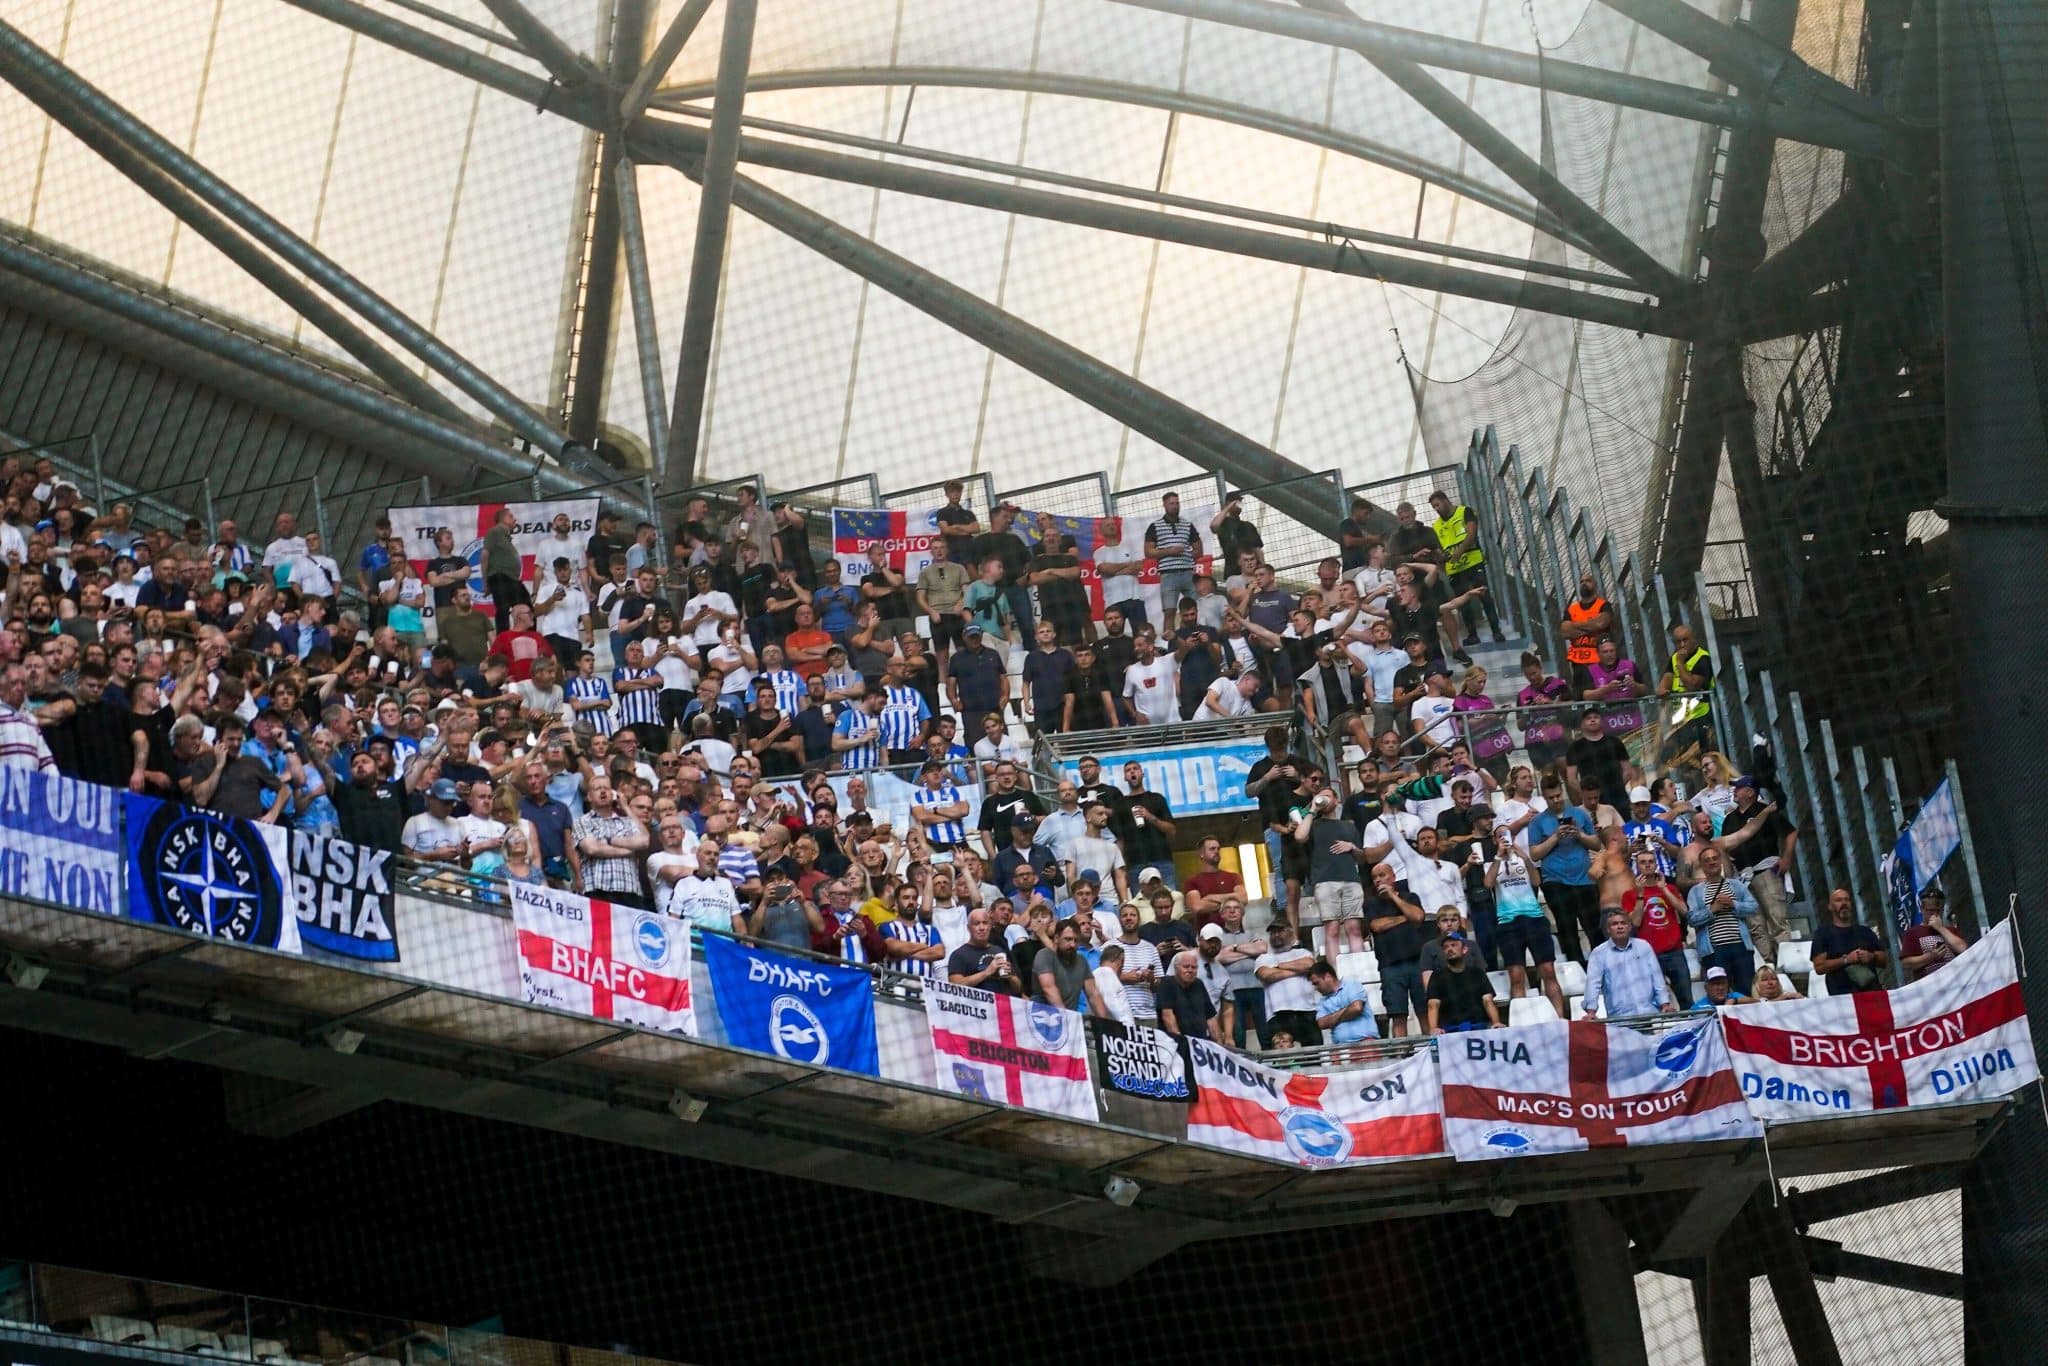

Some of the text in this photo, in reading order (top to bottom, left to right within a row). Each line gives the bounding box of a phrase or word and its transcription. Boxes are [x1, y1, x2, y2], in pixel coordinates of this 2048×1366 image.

[857, 535, 935, 552] BGHTO
[1608, 715, 1634, 728] 003
[46, 775, 113, 834] OUI
[164, 825, 250, 887] NSK BHA
[293, 829, 392, 895] NSK
[44, 856, 113, 917] NON
[293, 871, 393, 941] BHA
[567, 907, 583, 921] ED
[552, 941, 647, 1000] BHAFC
[748, 956, 832, 996] BHAFC
[938, 982, 995, 1004] LEONARDS
[938, 1000, 987, 1020] EAGULLS
[1102, 1033, 1159, 1063] NORTH
[1122, 1022, 1154, 1044] THE
[1790, 1013, 1966, 1064] BRIGHTON
[968, 1040, 1050, 1072] BRIGHTON
[1108, 1054, 1161, 1081] STAND
[1466, 1038, 1532, 1066] BHA
[1932, 1047, 2016, 1096] Dillon
[1359, 1074, 1407, 1102] ON
[1743, 1072, 1850, 1110] Damon
[1497, 1090, 1688, 1120] MAC'S ON TOUR
